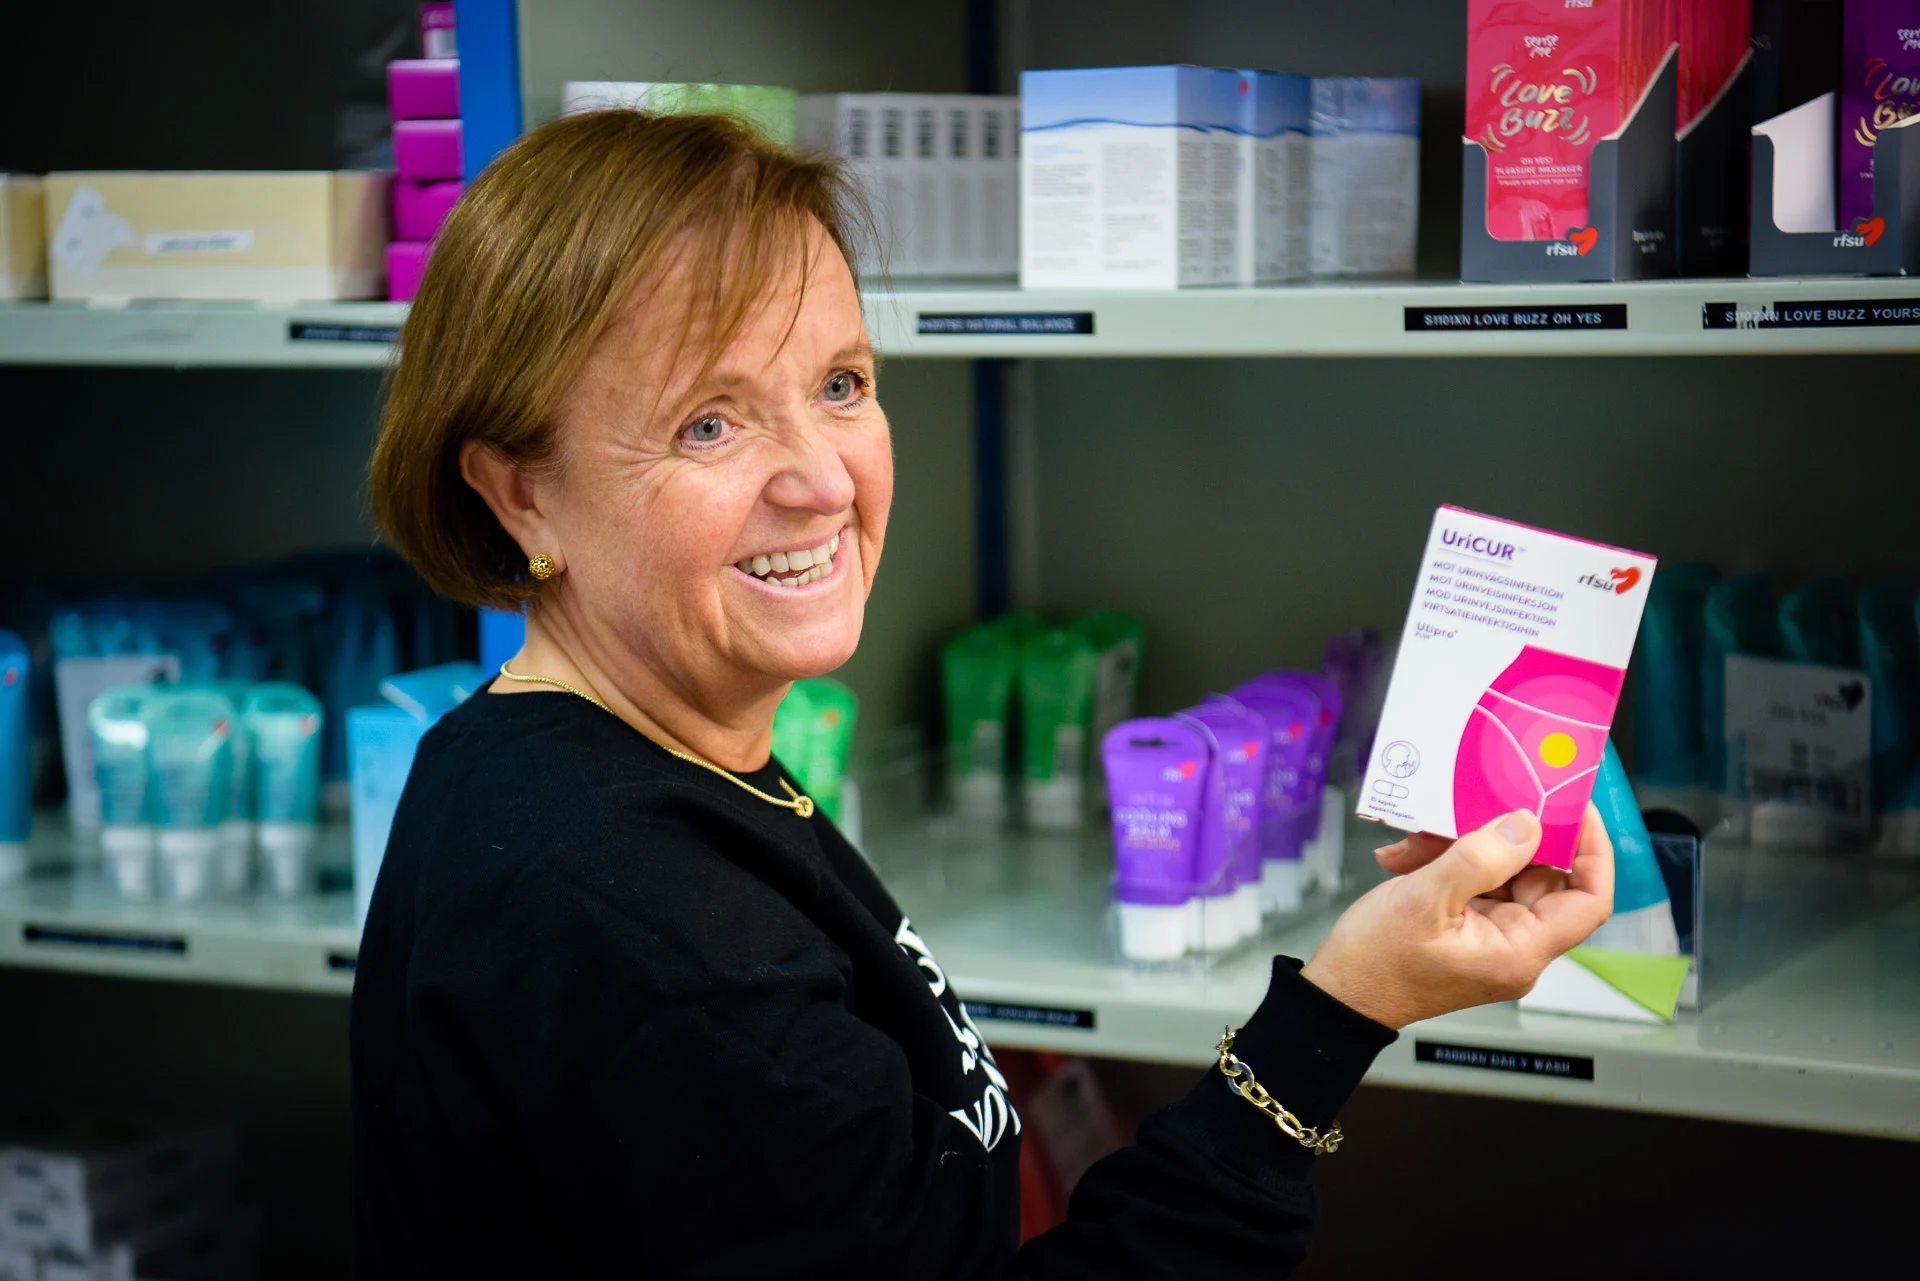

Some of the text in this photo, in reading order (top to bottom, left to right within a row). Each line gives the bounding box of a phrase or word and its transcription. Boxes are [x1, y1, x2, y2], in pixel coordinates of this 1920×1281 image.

[1833, 234, 1864, 247] rfsu
[1546, 242, 1578, 256] rfsu
[1474, 313, 1509, 326] LOVE
[1513, 312, 1549, 325] BUZZ
[1553, 312, 1572, 325] OH
[1576, 311, 1602, 324] YES
[1784, 309, 1822, 321] LOVE
[1827, 309, 1866, 321] BUZZ
[1872, 307, 1920, 319] YOURS
[1442, 528, 1516, 560] UriCUR
[1433, 560, 1456, 570] MOT
[1429, 574, 1452, 584] MOT
[1578, 573, 1615, 591] rfsu
[1426, 588, 1451, 599] MOD
